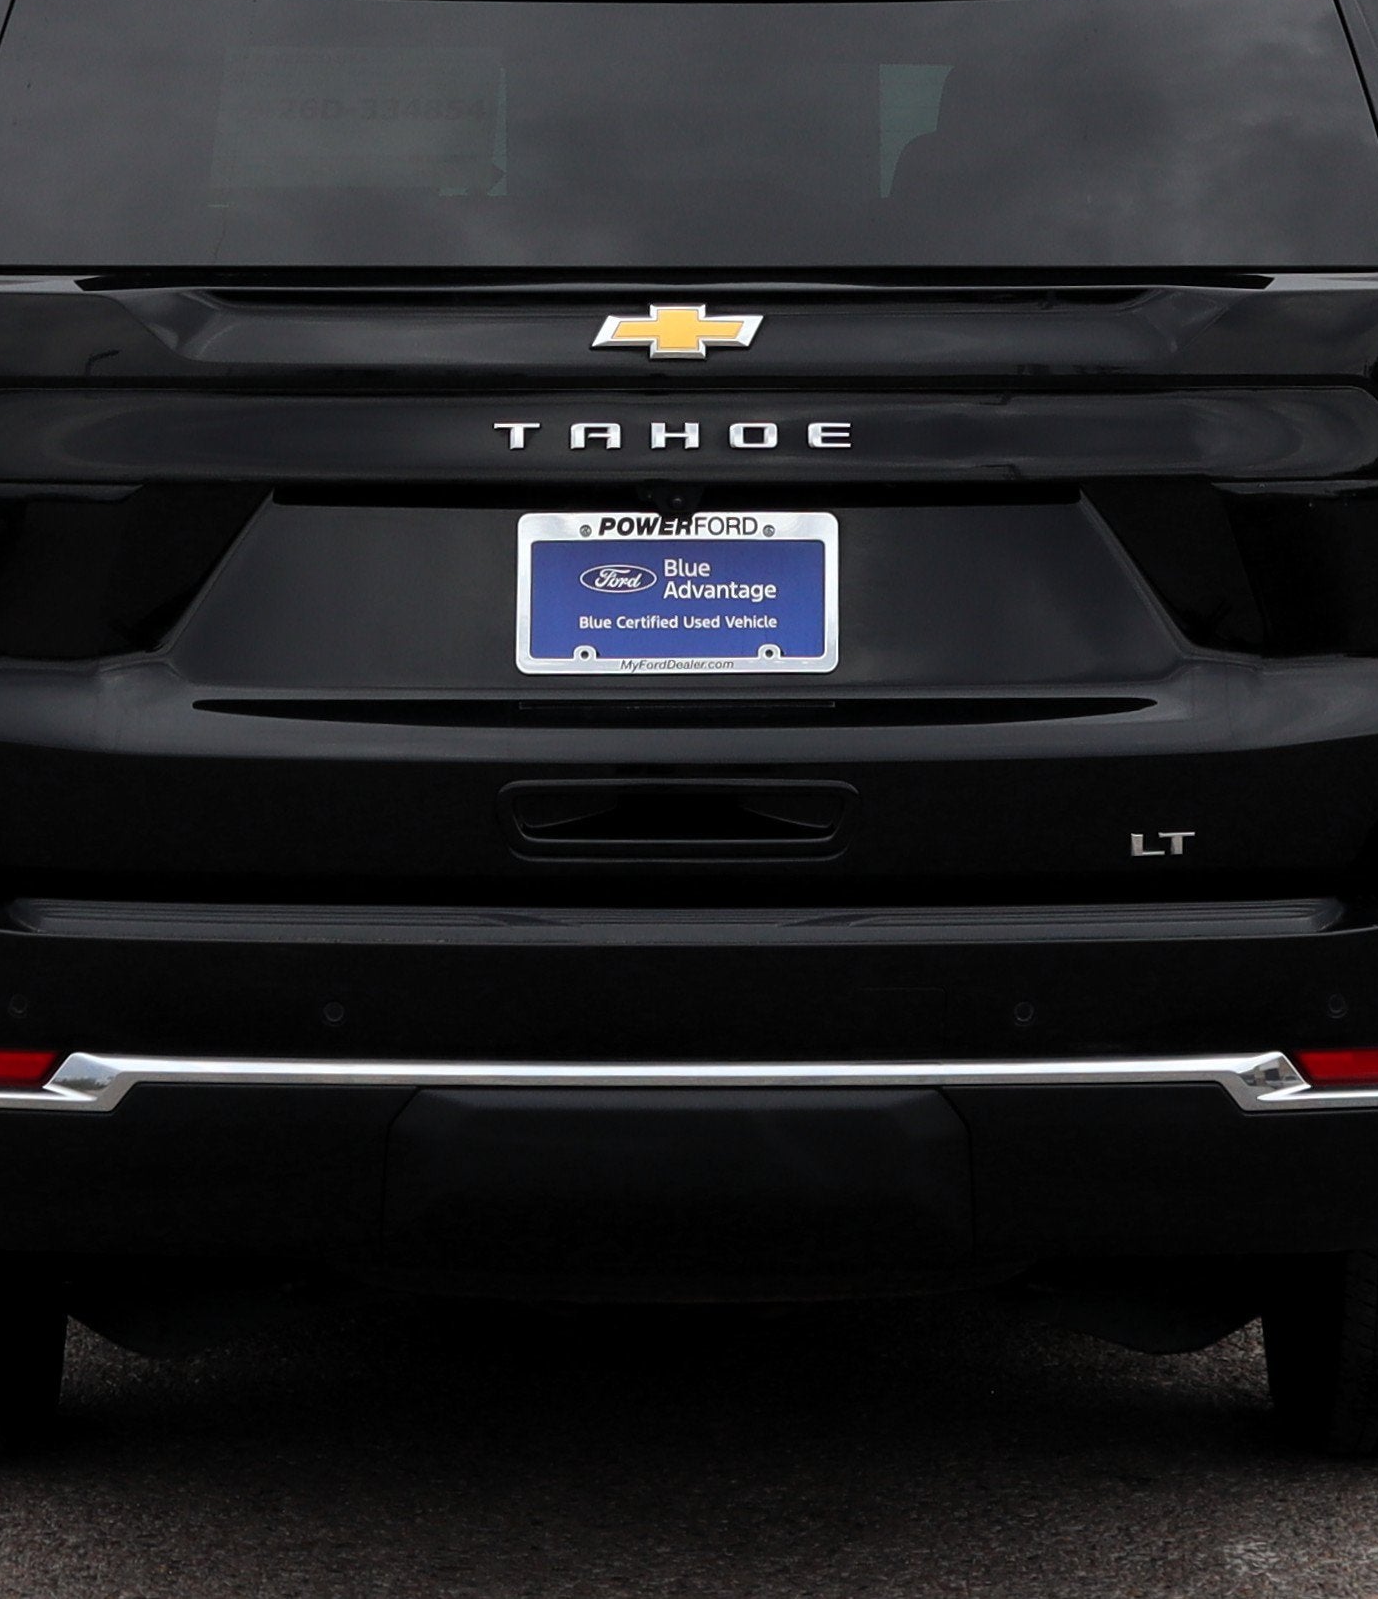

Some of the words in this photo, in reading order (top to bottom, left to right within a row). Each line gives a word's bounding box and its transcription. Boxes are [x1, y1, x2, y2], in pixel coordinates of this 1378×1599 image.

[493, 422, 852, 450] TAHOE
[598, 516, 758, 536] POWERFORD
[594, 567, 642, 589] Ford
[663, 558, 711, 577] Blue
[663, 581, 777, 603] Advantage
[579, 615, 612, 629] Blue
[616, 615, 679, 630] Certified
[683, 615, 720, 629] Used
[725, 615, 778, 629] Vehicle
[620, 659, 735, 673] MyFordDealer.com
[1130, 831, 1196, 857] LT
